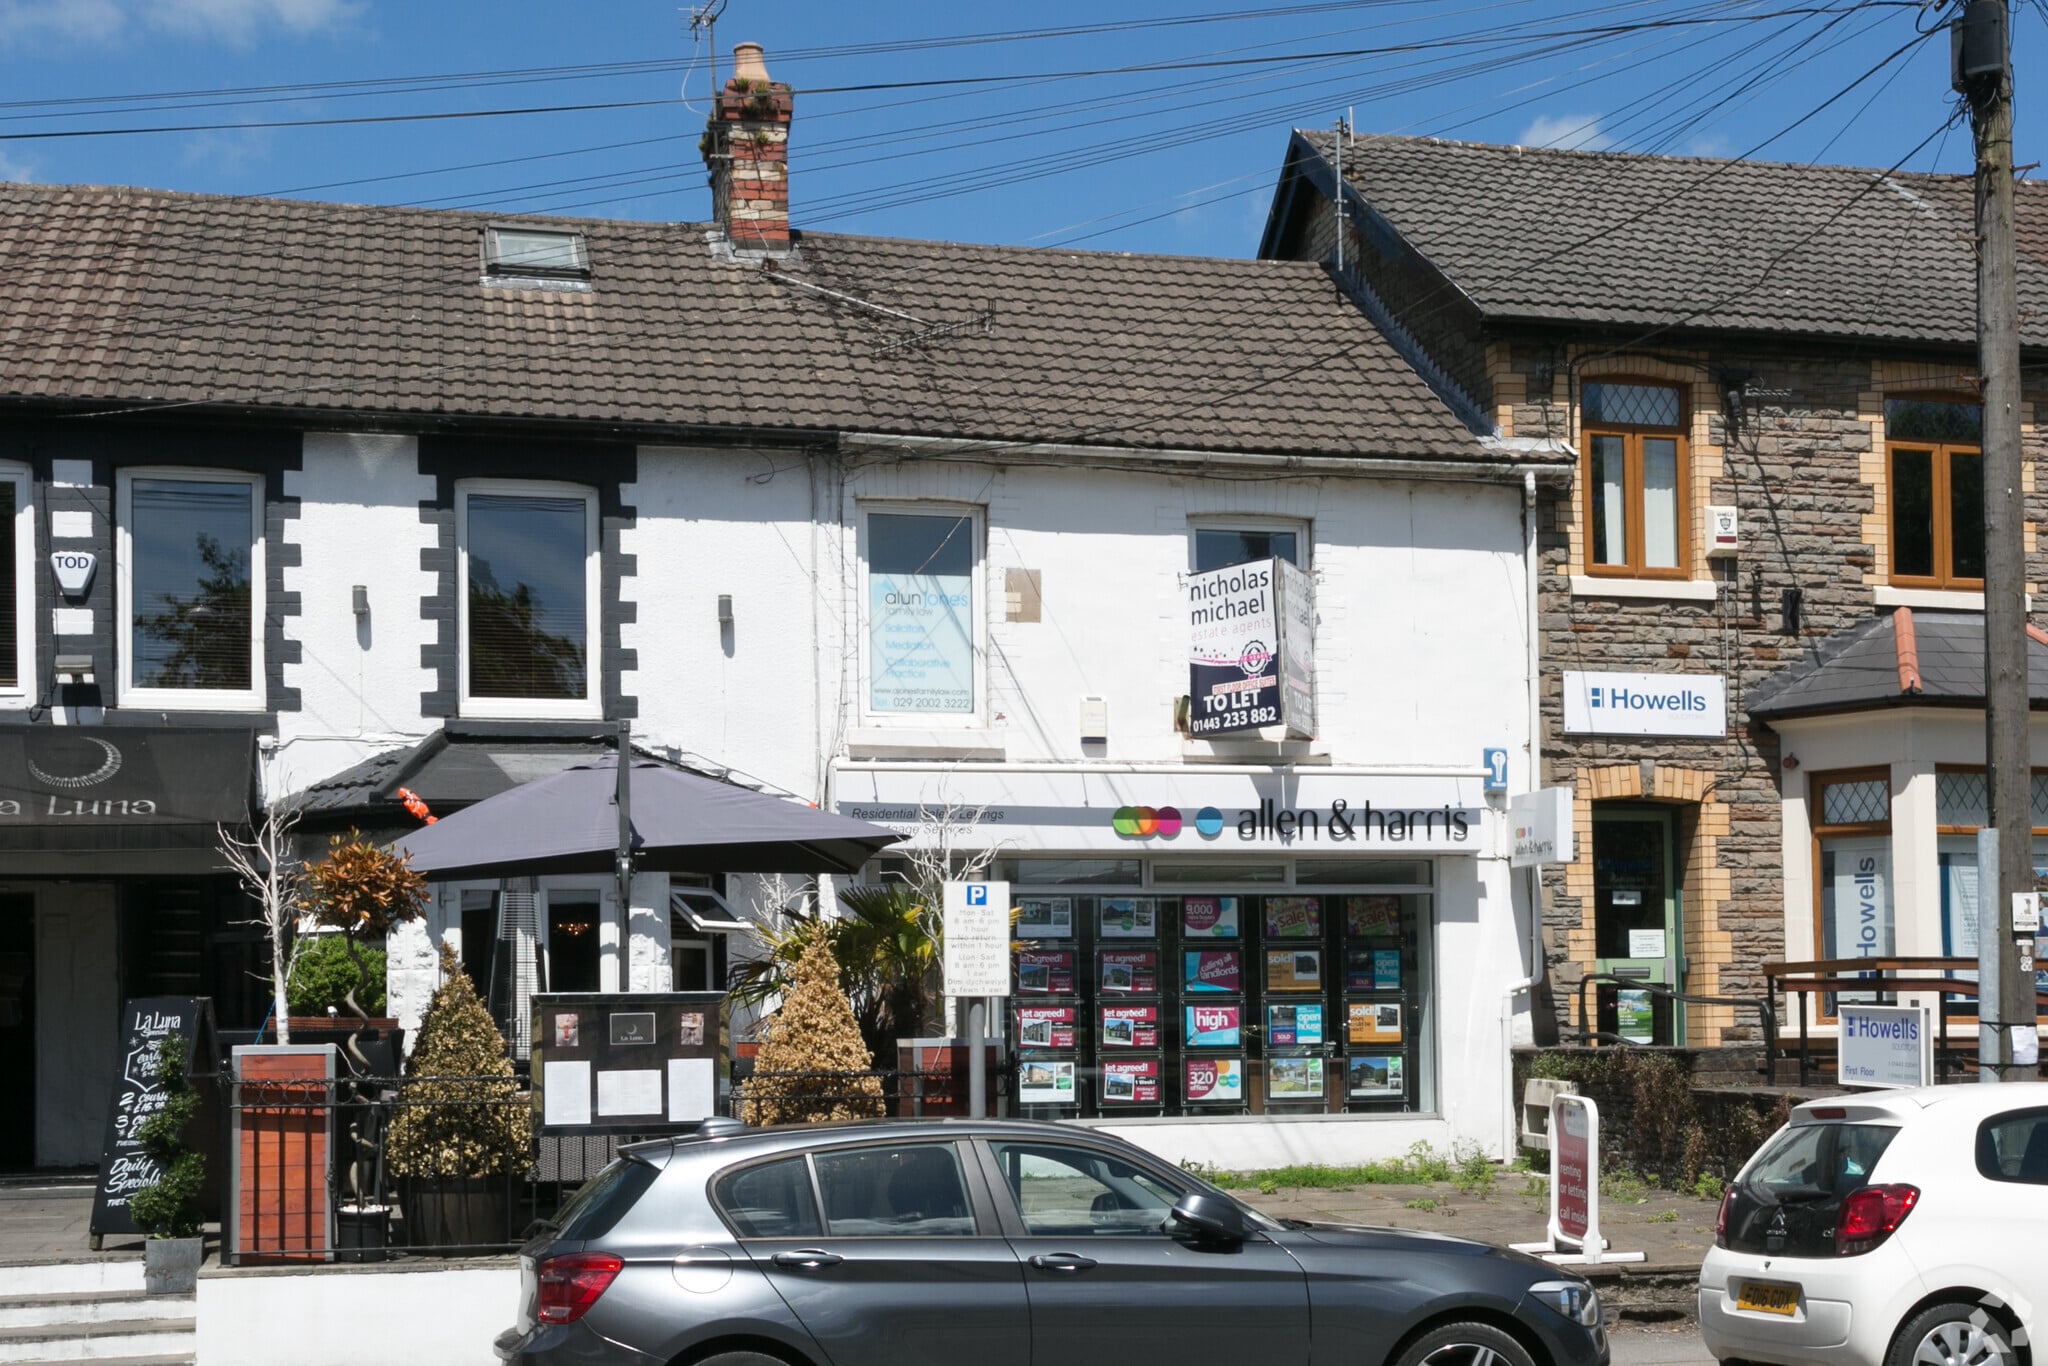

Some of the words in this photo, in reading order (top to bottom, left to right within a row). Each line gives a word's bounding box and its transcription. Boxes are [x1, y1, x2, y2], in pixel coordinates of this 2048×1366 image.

[55, 556, 89, 569] TOD
[1190, 568, 1269, 602] nicholas
[884, 591, 922, 605] alun
[1191, 589, 1265, 626] michael
[1191, 624, 1229, 642] estate
[1232, 616, 1272, 636] agents
[1242, 678, 1258, 692] OFFICE
[893, 697, 913, 708] 029
[916, 698, 942, 708] 2002
[944, 698, 970, 709] 3222
[1203, 694, 1228, 713] TO
[1231, 688, 1262, 710] LET
[1611, 688, 1707, 712] Howells
[1192, 717, 1220, 732] 01443
[1223, 711, 1248, 728] 233
[1250, 706, 1276, 724] 882
[0, 799, 21, 816] a
[47, 795, 157, 816] Luna
[852, 808, 917, 820] Residential
[1238, 798, 1319, 838] allen
[1328, 798, 1357, 839] &
[1365, 799, 1469, 840] harris
[970, 886, 984, 904] P
[1854, 856, 1877, 958] Howells
[1278, 910, 1305, 928] sale
[1360, 910, 1385, 928] sale
[1020, 954, 1030, 962] let
[1032, 954, 1062, 964] agreed!
[1103, 954, 1114, 962] let
[1116, 954, 1146, 964] agreed!
[1200, 958, 1224, 973] calling
[1224, 952, 1232, 964] all
[1200, 964, 1240, 980] landlords
[134, 1011, 152, 1031] La
[153, 1010, 181, 1030] Luna
[1022, 1008, 1032, 1018] let
[1034, 1008, 1065, 1019] agreed!
[1104, 1008, 1115, 1018] let
[1116, 1008, 1148, 1019] agreed!
[1196, 1011, 1228, 1030] high
[1297, 1012, 1320, 1024] open
[1859, 1016, 1918, 1040] Howells
[1104, 1064, 1116, 1073] let
[1117, 1064, 1148, 1074] agreed!
[1190, 1071, 1214, 1085] 320
[1844, 1065, 1858, 1076] First
[1860, 1066, 1876, 1077] Floor
[118, 1092, 135, 1106] 2
[114, 1114, 129, 1128] 3
[110, 1155, 155, 1179] Daily
[1560, 1164, 1582, 1182] renting
[104, 1168, 161, 1194] Specials
[1560, 1184, 1568, 1194] or
[1560, 1207, 1570, 1220] call
